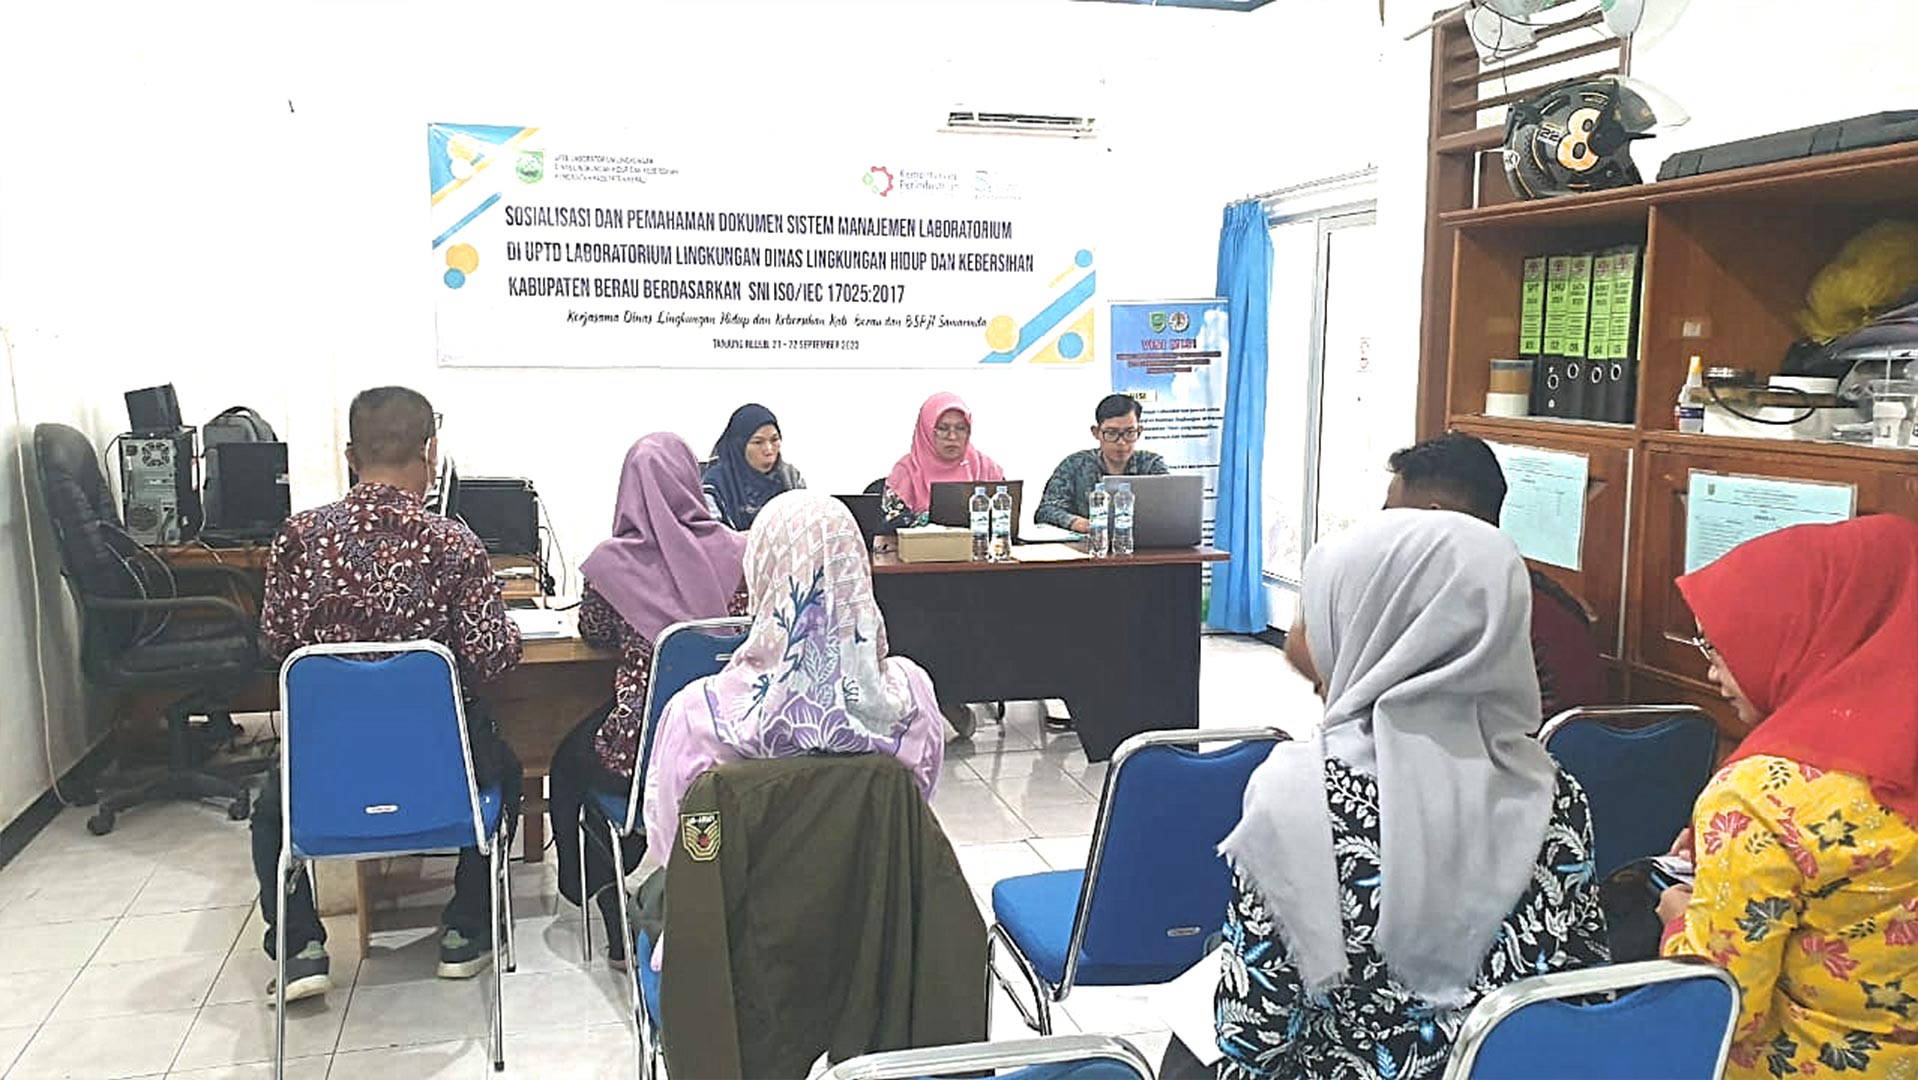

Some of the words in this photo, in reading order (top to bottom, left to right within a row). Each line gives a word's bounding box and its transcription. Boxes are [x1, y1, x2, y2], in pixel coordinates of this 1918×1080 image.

[505, 205, 591, 228] SOSIALISASI
[595, 208, 623, 229] DAN
[627, 209, 715, 232] PEMAHAMAN
[719, 212, 783, 234] DOKUMEN
[787, 214, 834, 235] SISTEM
[838, 216, 916, 238] MANAJEMEN
[919, 218, 1012, 240] LABORATORIUM
[507, 241, 521, 261] DI
[525, 241, 561, 262] UPTD
[565, 243, 672, 265] LABORATORIUM
[676, 246, 760, 267] LINGKUNGAN
[764, 248, 803, 268] DINAS
[806, 249, 887, 270] LINGKUNGAN
[891, 251, 927, 271] HIDUP
[931, 252, 956, 271] DAN
[959, 253, 1034, 273] KEBERSIHAN
[509, 276, 591, 298] KABUPATEN
[594, 278, 640, 298] BERAU
[644, 279, 742, 301] BERDASARKAN
[748, 282, 771, 301] SNI
[774, 282, 824, 302] ISO/IEC
[828, 283, 905, 304] 17025:2017
[566, 309, 619, 327] Kerjasama
[623, 309, 652, 325] Dinas
[656, 310, 716, 328] Lingkungan
[719, 311, 750, 329] Hidup
[752, 312, 771, 326] dan
